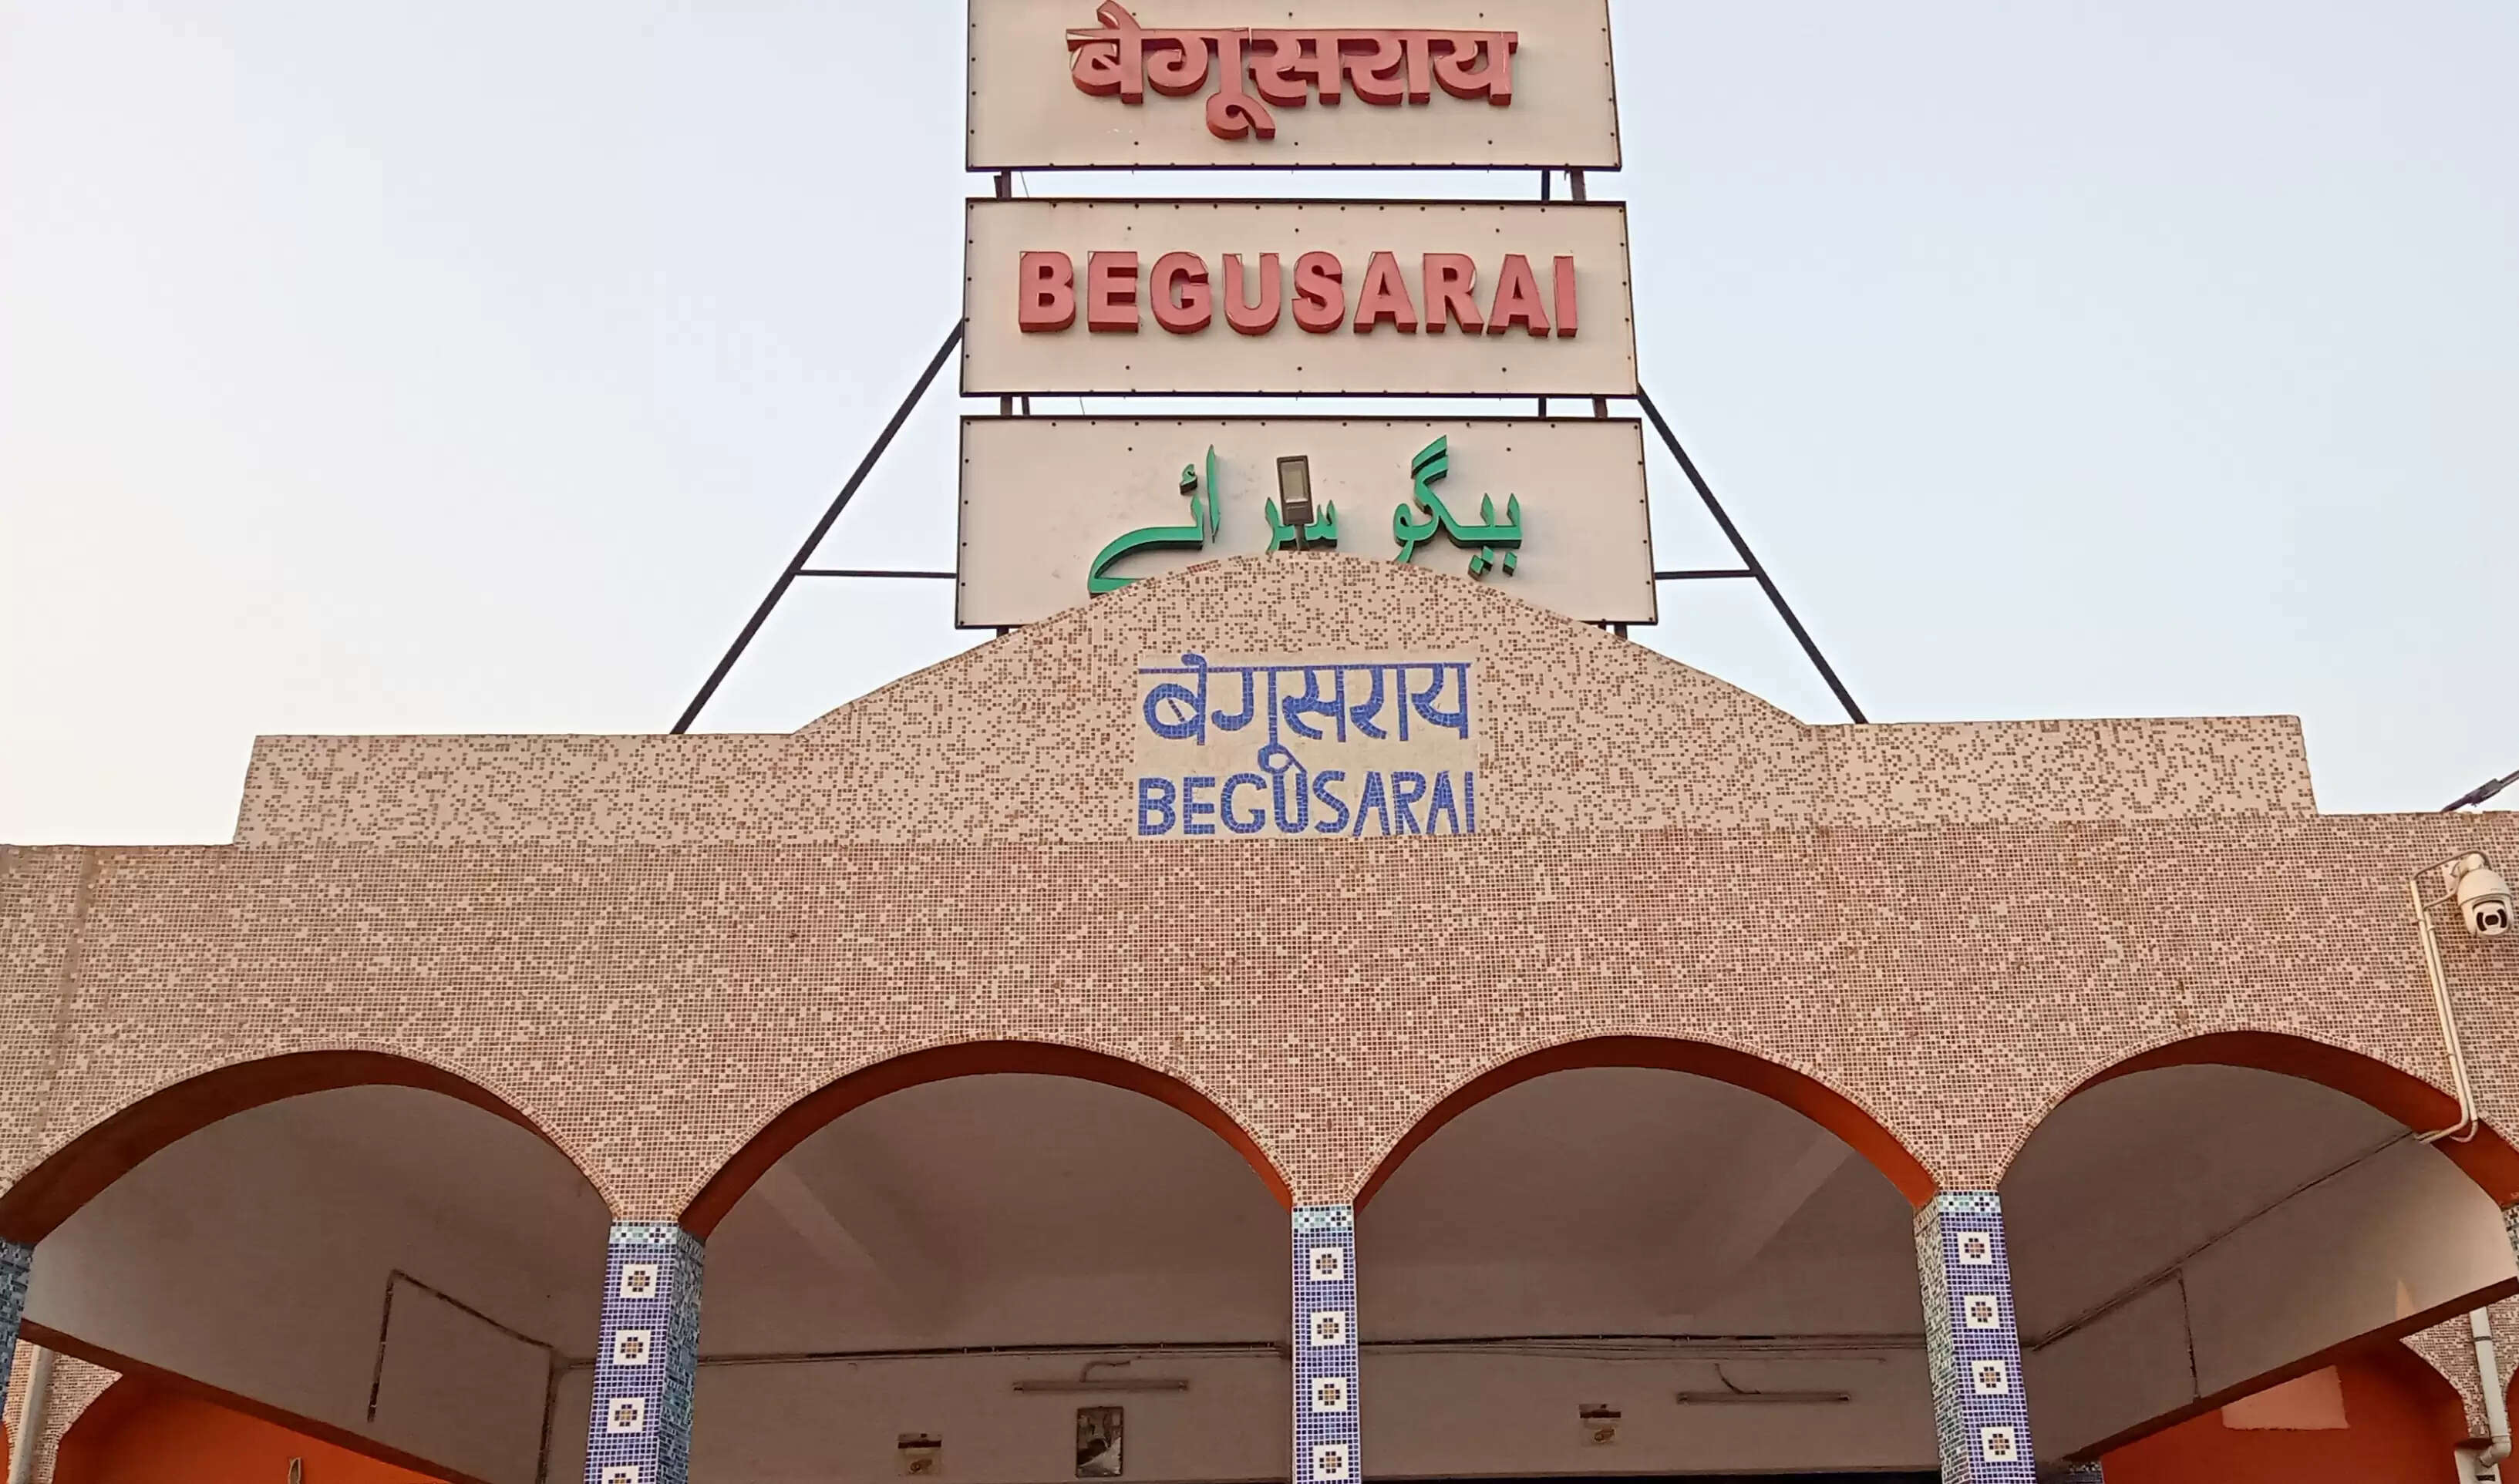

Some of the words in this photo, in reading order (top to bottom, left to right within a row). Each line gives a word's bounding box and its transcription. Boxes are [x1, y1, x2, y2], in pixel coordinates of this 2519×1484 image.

[1066, 0, 1518, 140] बेगूसराय
[1019, 251, 1578, 338] BEGUSARAI
[1138, 653, 1472, 773] बेगूसराय
[1138, 770, 1476, 836] BEGUSARAI
